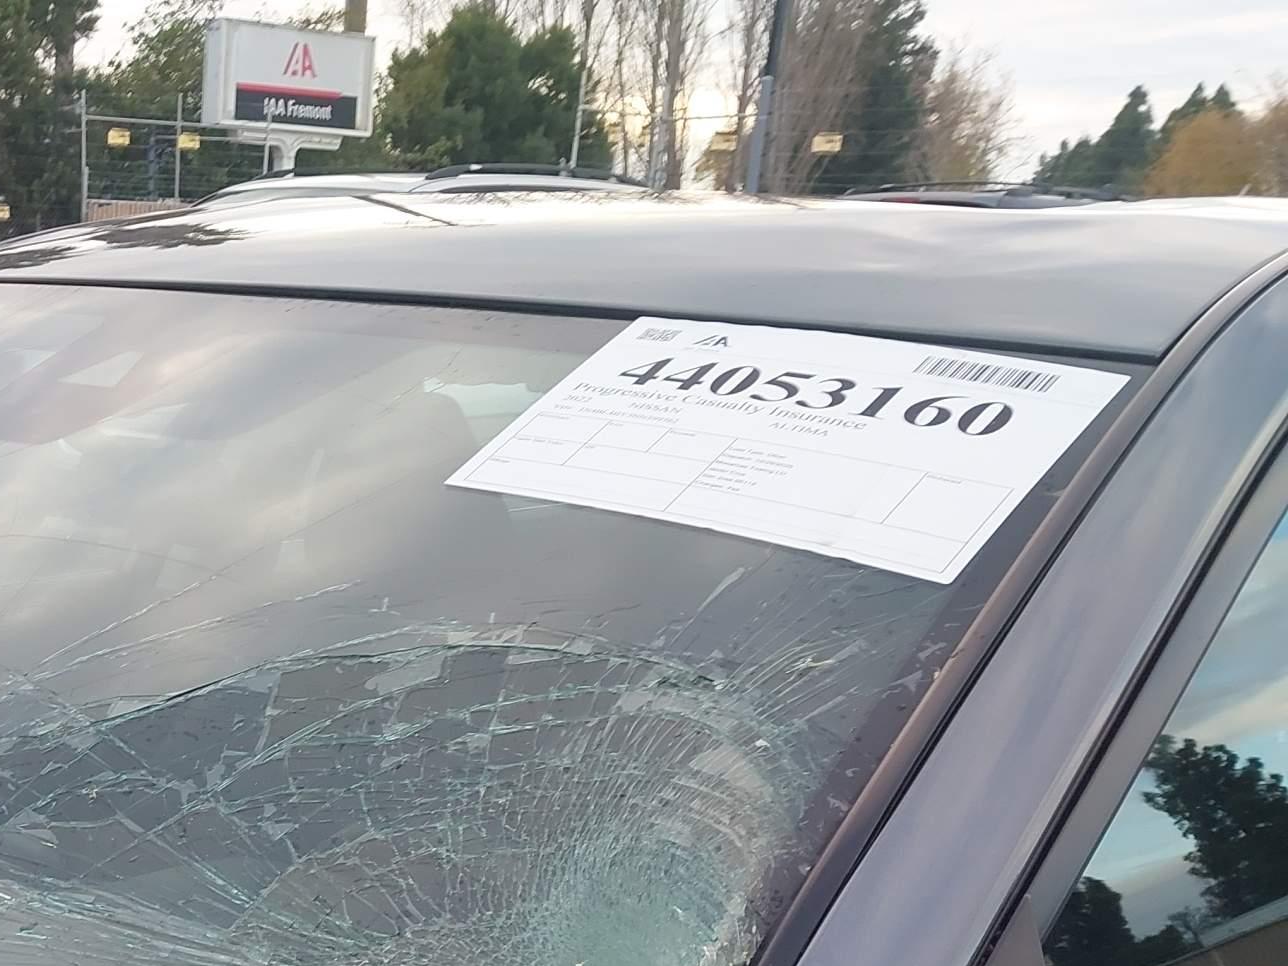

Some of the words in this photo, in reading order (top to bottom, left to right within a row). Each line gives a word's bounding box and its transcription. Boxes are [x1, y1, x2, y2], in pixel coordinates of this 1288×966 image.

[287, 99, 332, 121] Fremont
[573, 382, 677, 402] Progressive
[682, 394, 765, 416] Casualty
[769, 406, 868, 430] Insurance
[618, 357, 1014, 437] 44053160
[627, 402, 683, 414] NISSAN
[768, 421, 829, 437] ALTIMA
